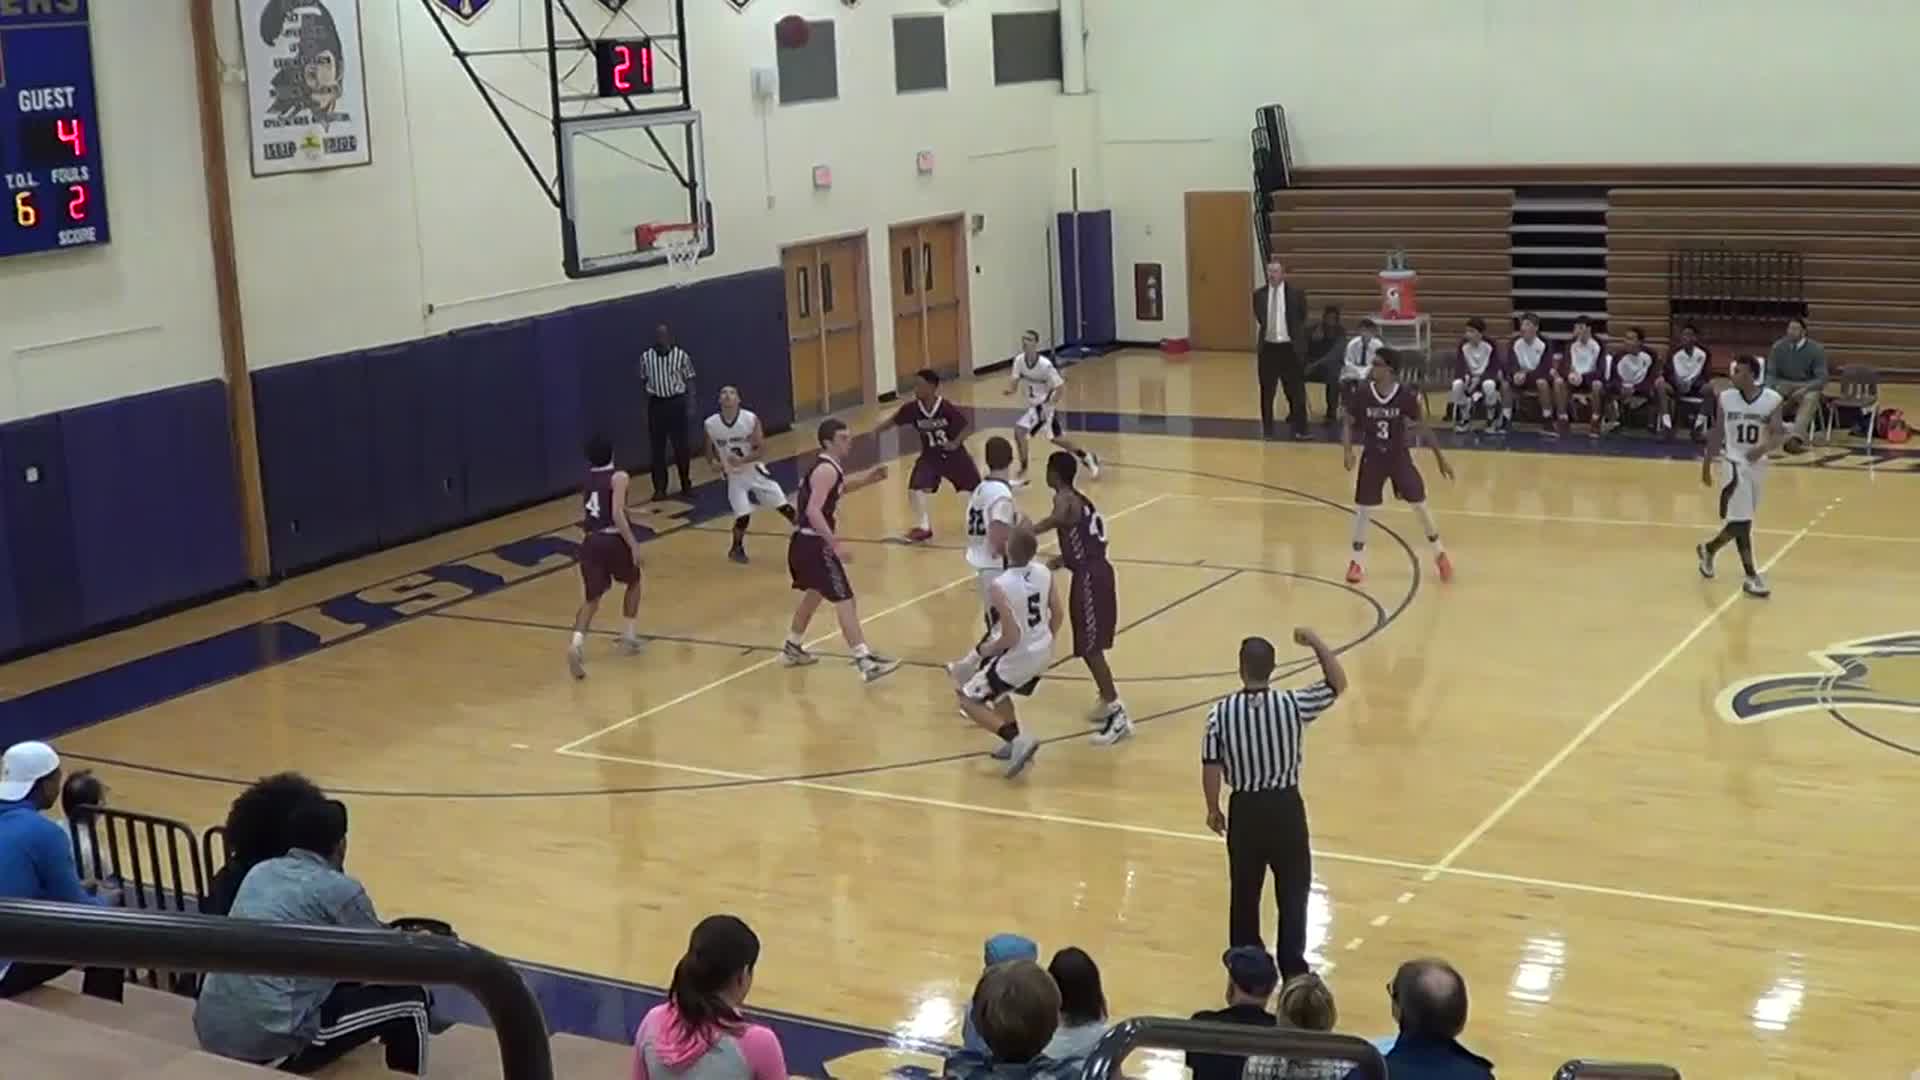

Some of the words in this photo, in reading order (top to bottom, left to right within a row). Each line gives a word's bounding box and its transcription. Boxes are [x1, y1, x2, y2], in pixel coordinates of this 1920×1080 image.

[613, 44, 649, 90] 21
[18, 86, 75, 112] GUEST
[57, 119, 82, 156] 4
[51, 165, 90, 184] FOULS
[15, 191, 36, 226] 6
[69, 185, 85, 220] 2
[58, 227, 97, 245] SCORE
[926, 429, 948, 446] 13
[1376, 420, 1389, 439] 3
[1737, 423, 1759, 444] 10
[585, 491, 600, 518] 4
[1027, 591, 1042, 628] 5
